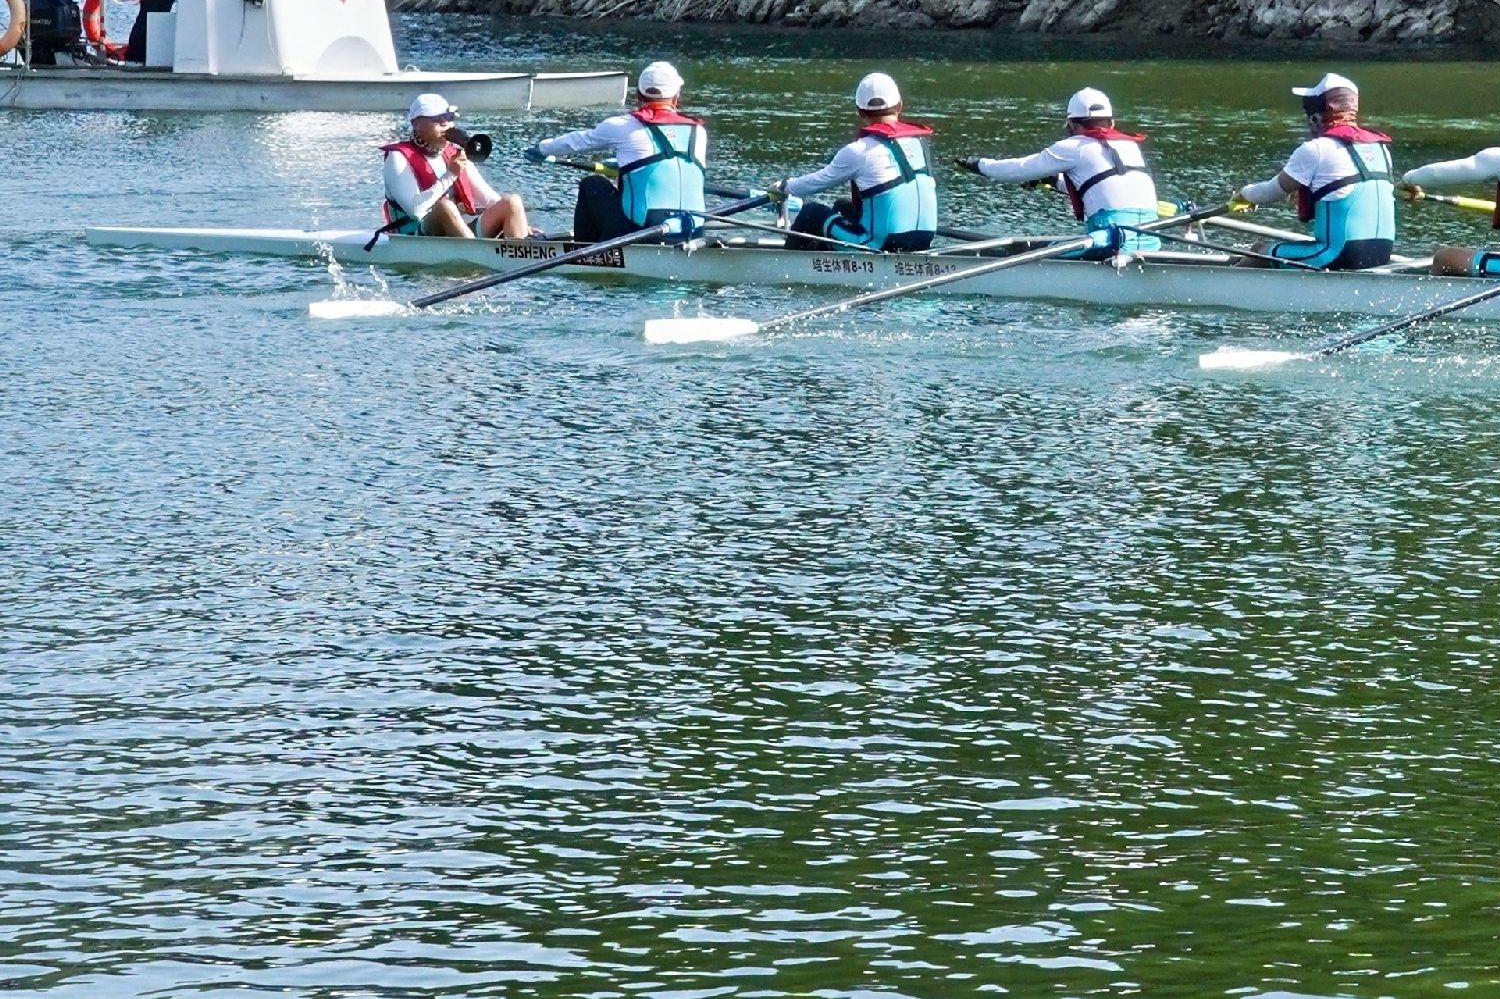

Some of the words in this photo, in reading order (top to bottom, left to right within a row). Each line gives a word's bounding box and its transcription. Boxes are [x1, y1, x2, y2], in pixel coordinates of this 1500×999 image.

[500, 244, 557, 259] PEISHENG
[812, 257, 874, 273] 培生体育8-13
